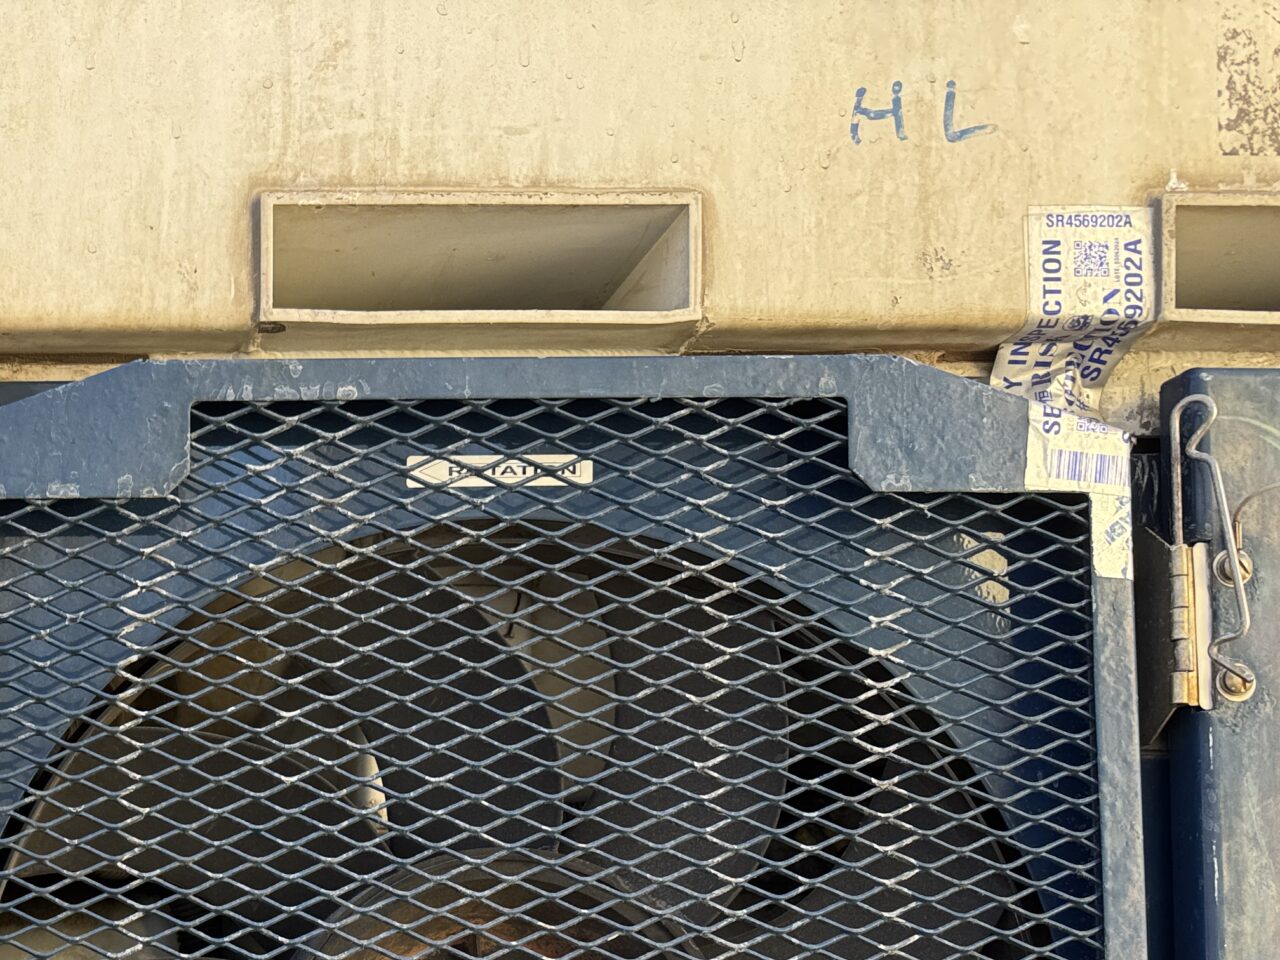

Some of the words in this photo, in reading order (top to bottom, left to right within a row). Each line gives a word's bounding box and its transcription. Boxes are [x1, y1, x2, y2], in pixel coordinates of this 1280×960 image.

[1045, 214, 1133, 228] SR4569202A
[1007, 240, 1062, 365] INSPECTION
[1080, 238, 1143, 381] SR4569202A
